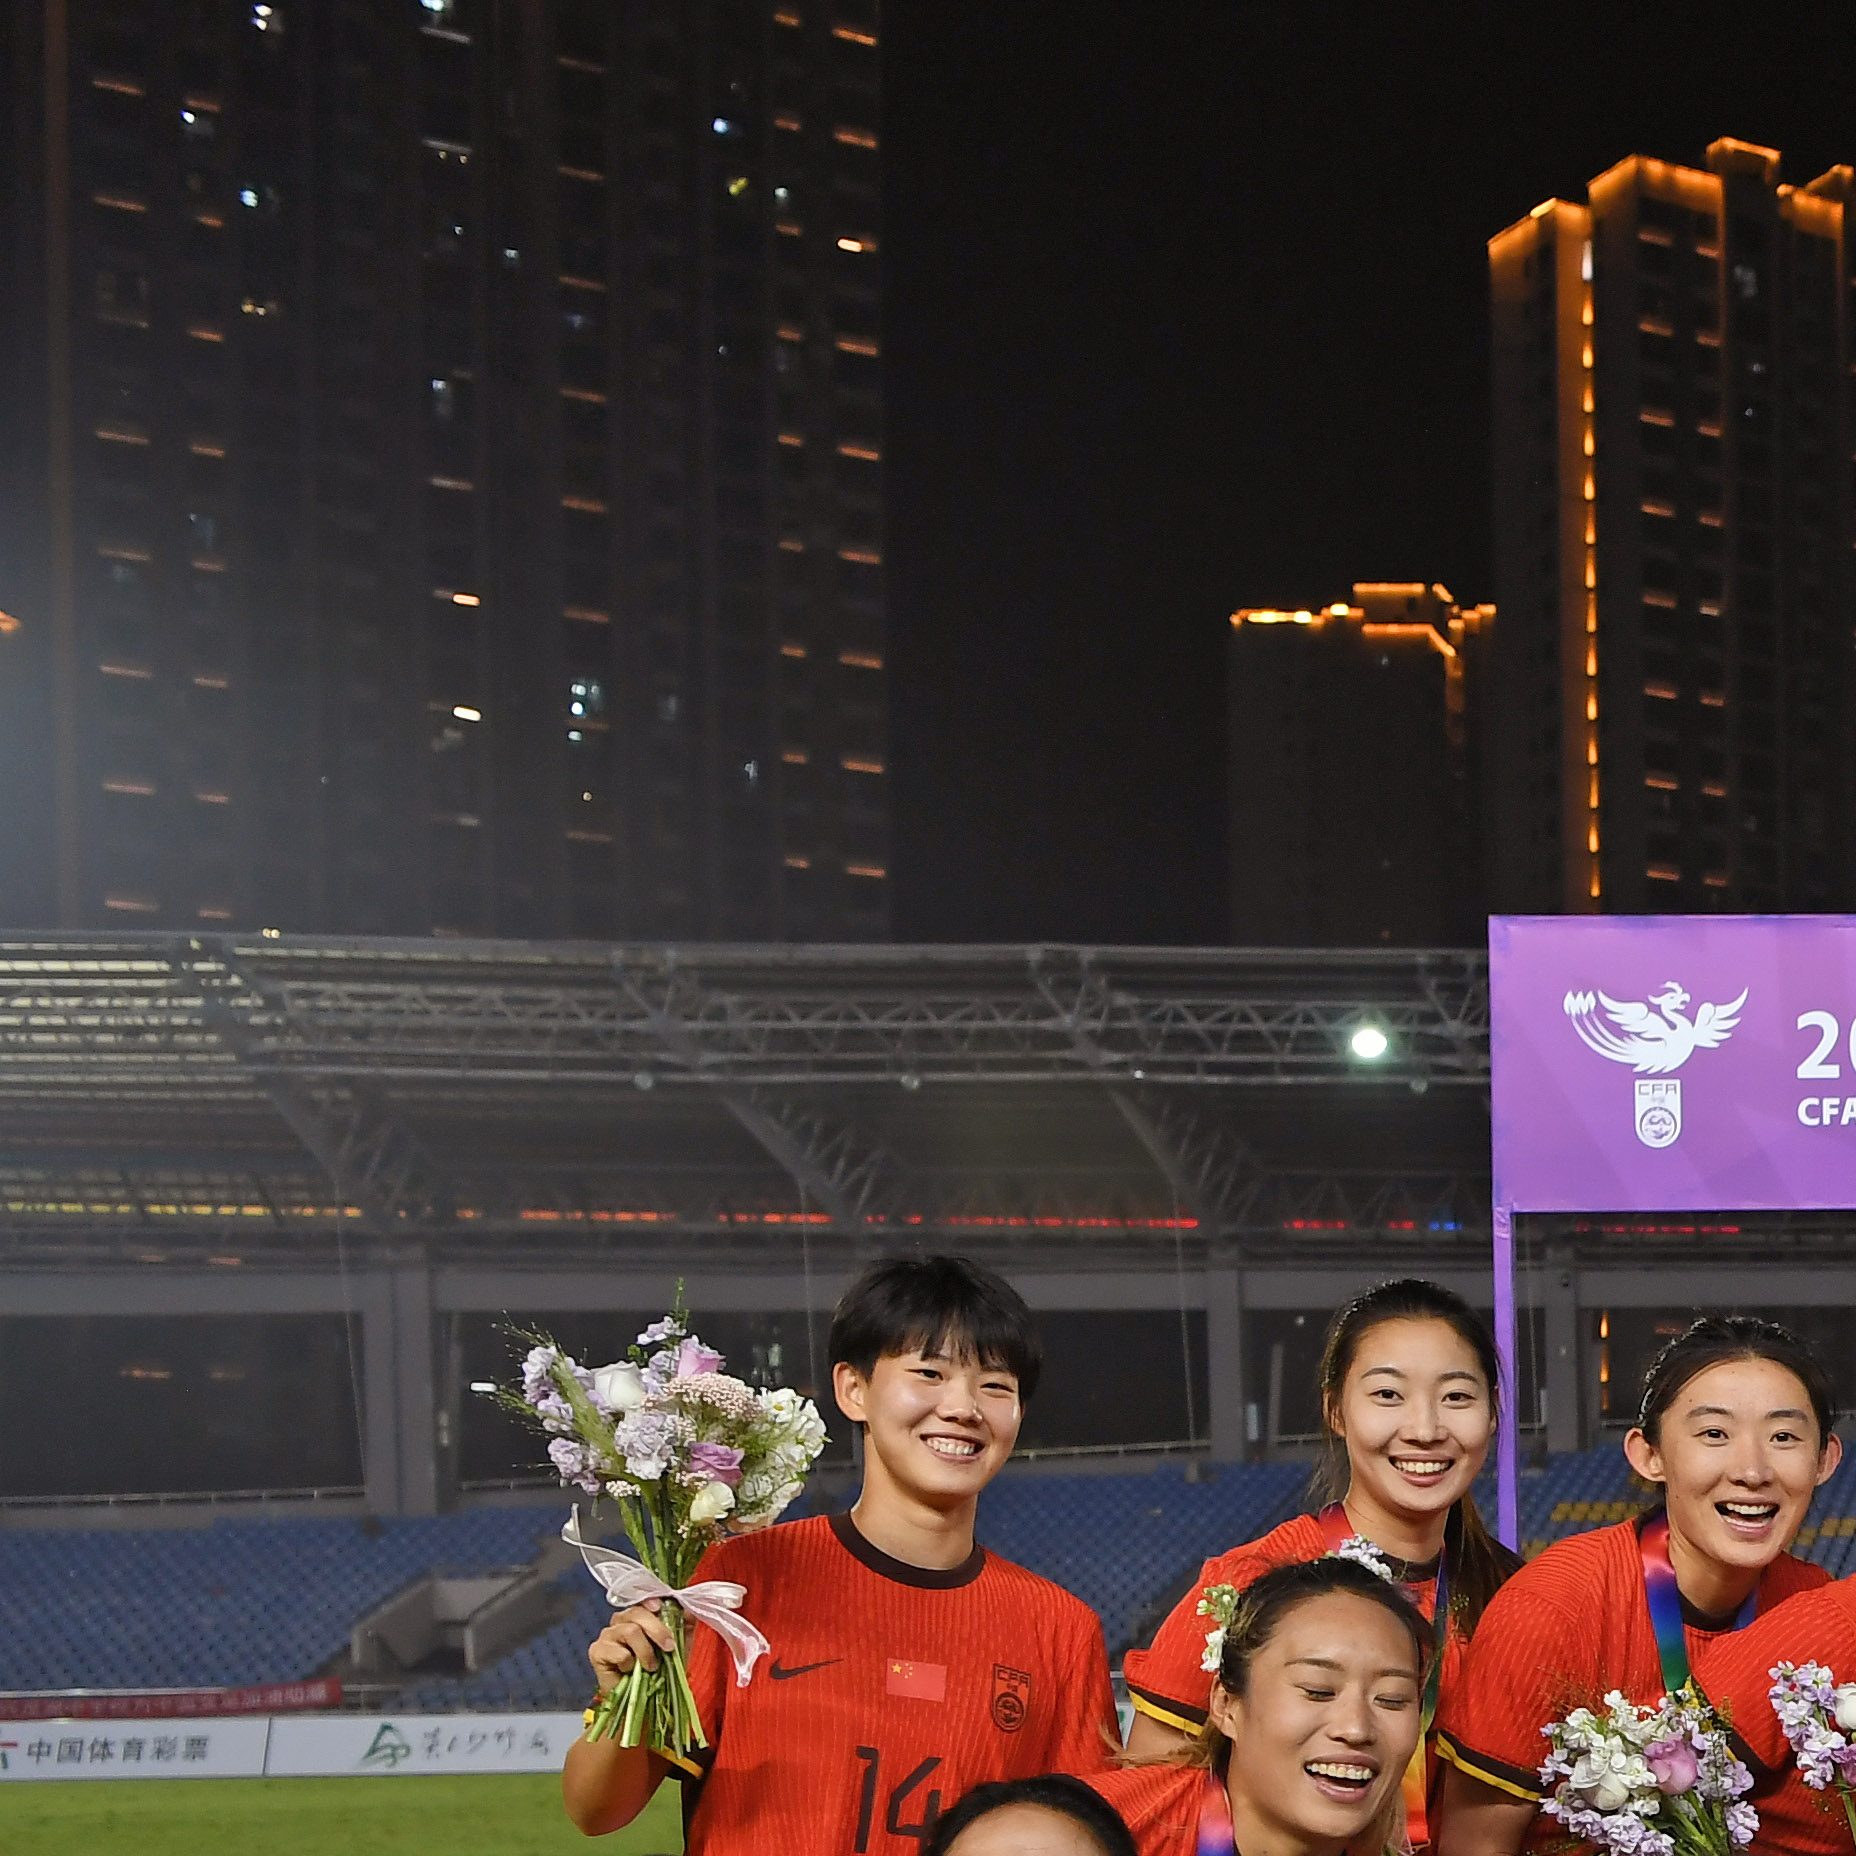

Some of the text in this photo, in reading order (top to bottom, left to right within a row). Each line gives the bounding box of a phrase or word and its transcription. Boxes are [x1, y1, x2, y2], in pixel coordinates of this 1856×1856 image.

[26, 1736, 210, 1764] 中国体育彩票
